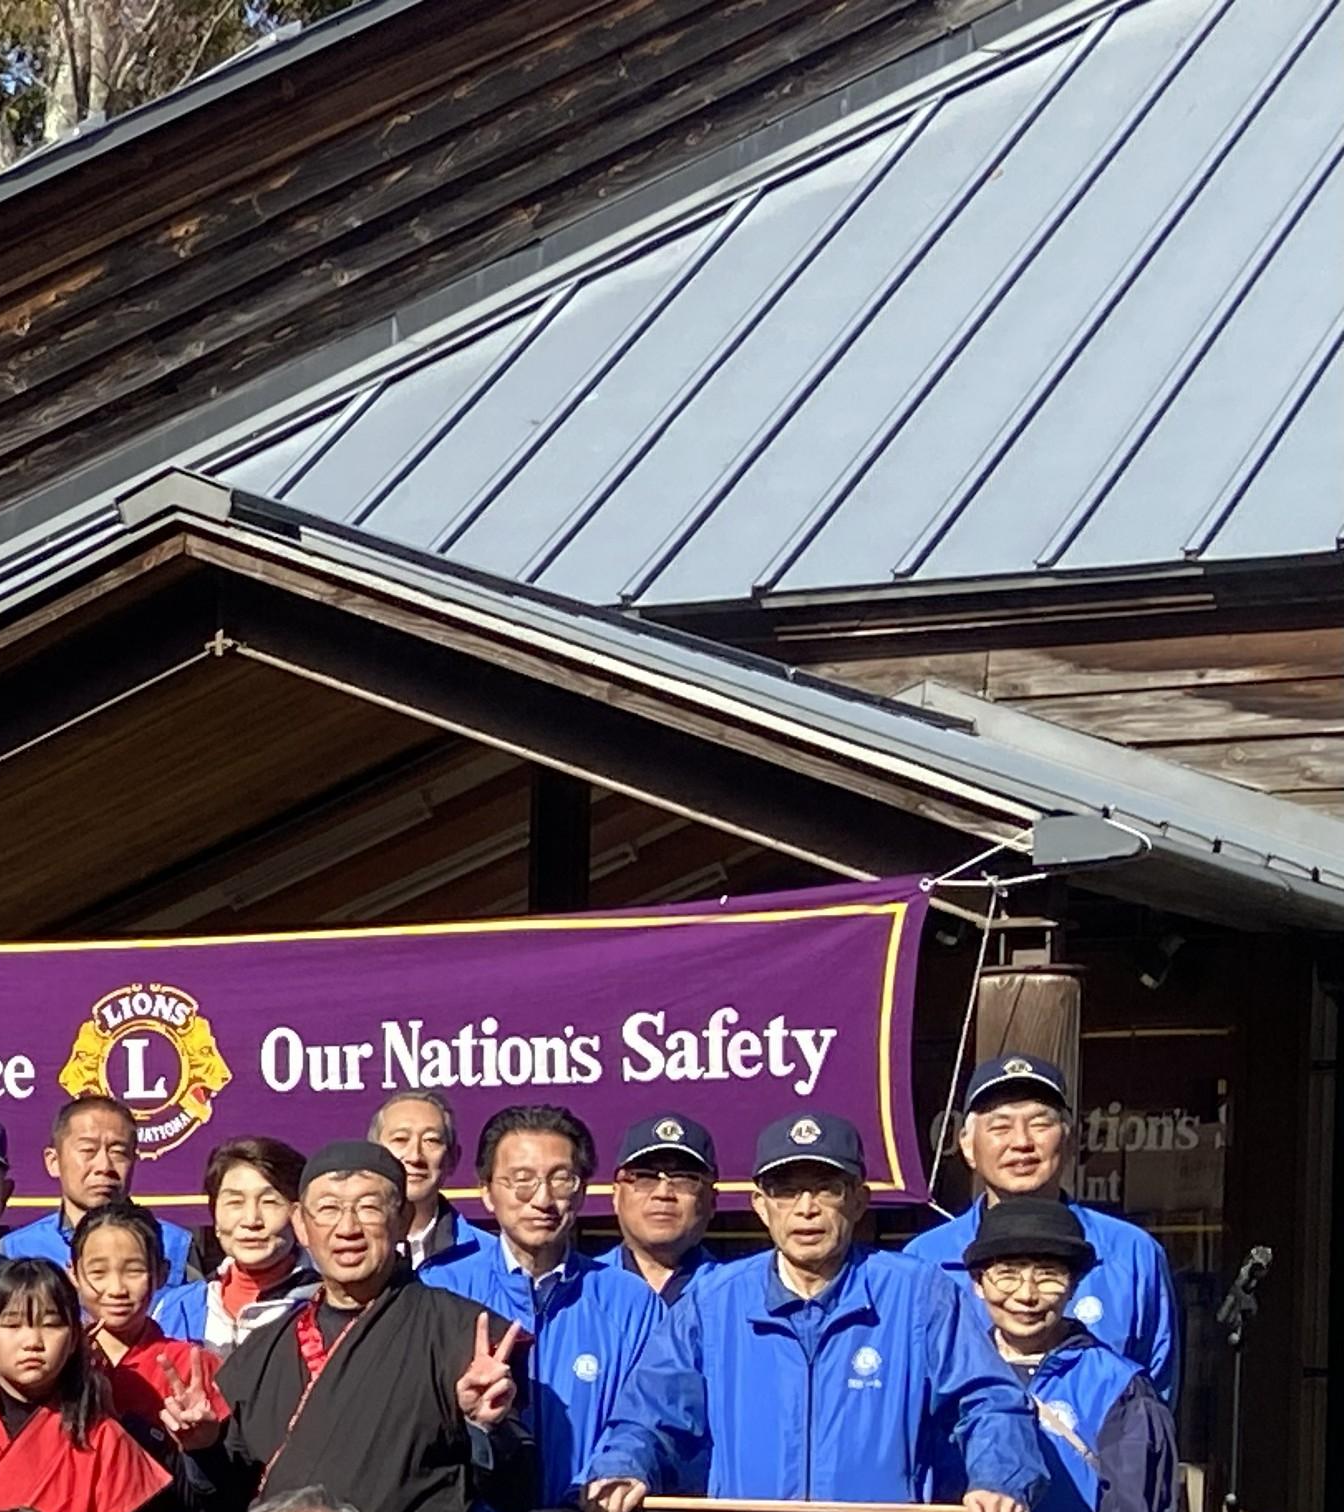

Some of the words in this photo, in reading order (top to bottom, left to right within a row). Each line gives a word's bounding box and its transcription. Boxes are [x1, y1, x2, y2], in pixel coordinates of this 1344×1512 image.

[100, 992, 191, 1029] LIONS
[121, 1038, 169, 1099] L
[260, 1026, 374, 1092] Our
[381, 1016, 603, 1089] Nation's
[622, 1006, 838, 1096] Safety
